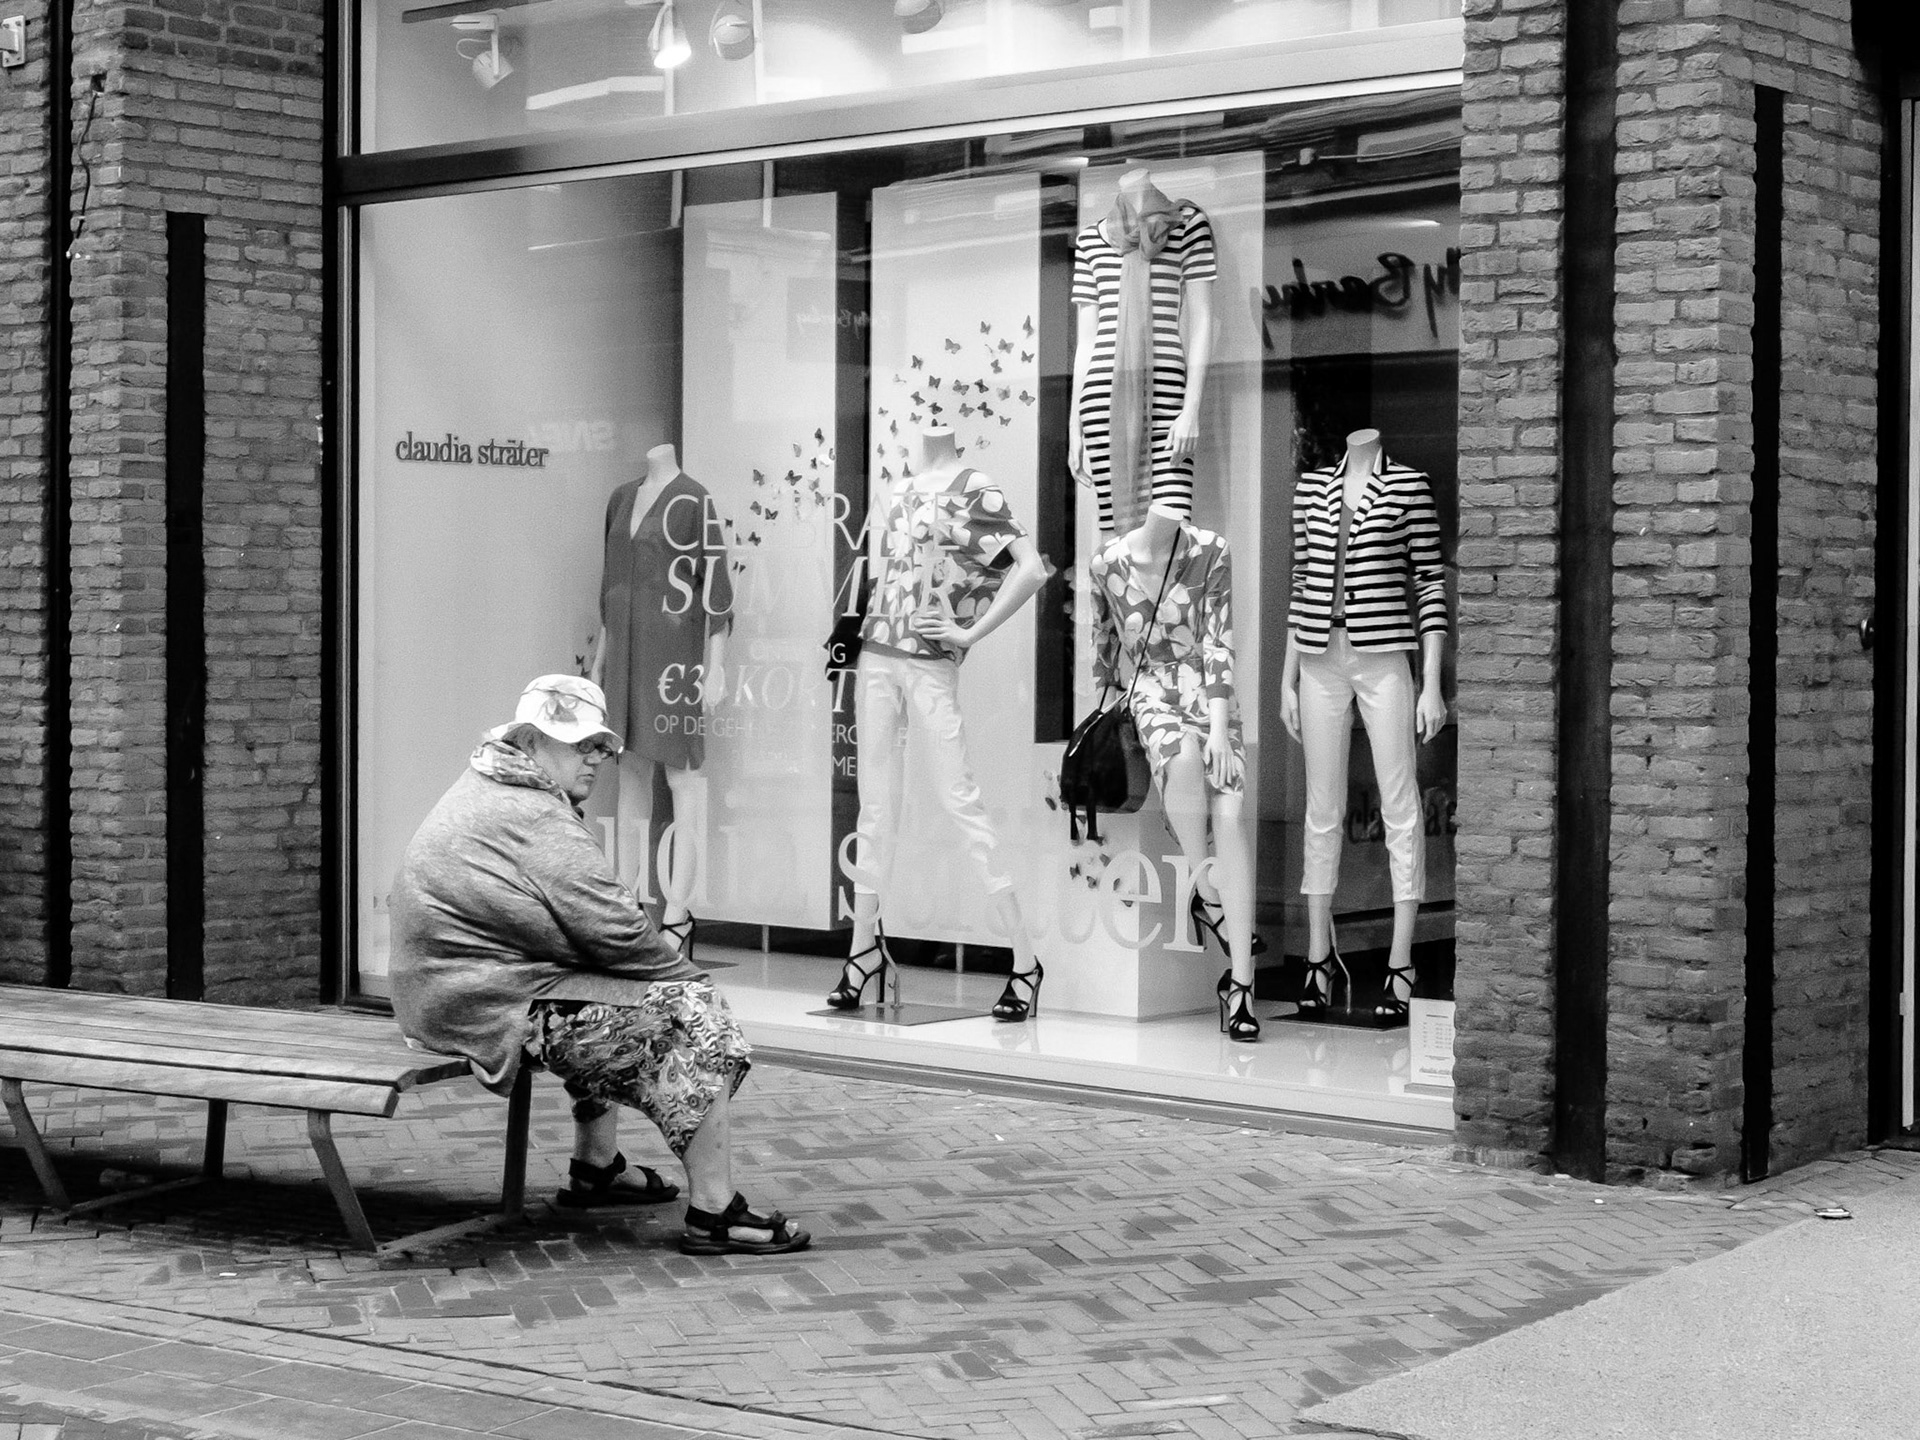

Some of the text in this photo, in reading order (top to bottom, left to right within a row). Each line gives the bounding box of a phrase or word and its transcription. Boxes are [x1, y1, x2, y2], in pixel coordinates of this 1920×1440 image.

[396, 431, 472, 464] claudia
[654, 714, 679, 735] OP
[684, 716, 706, 736] DE
